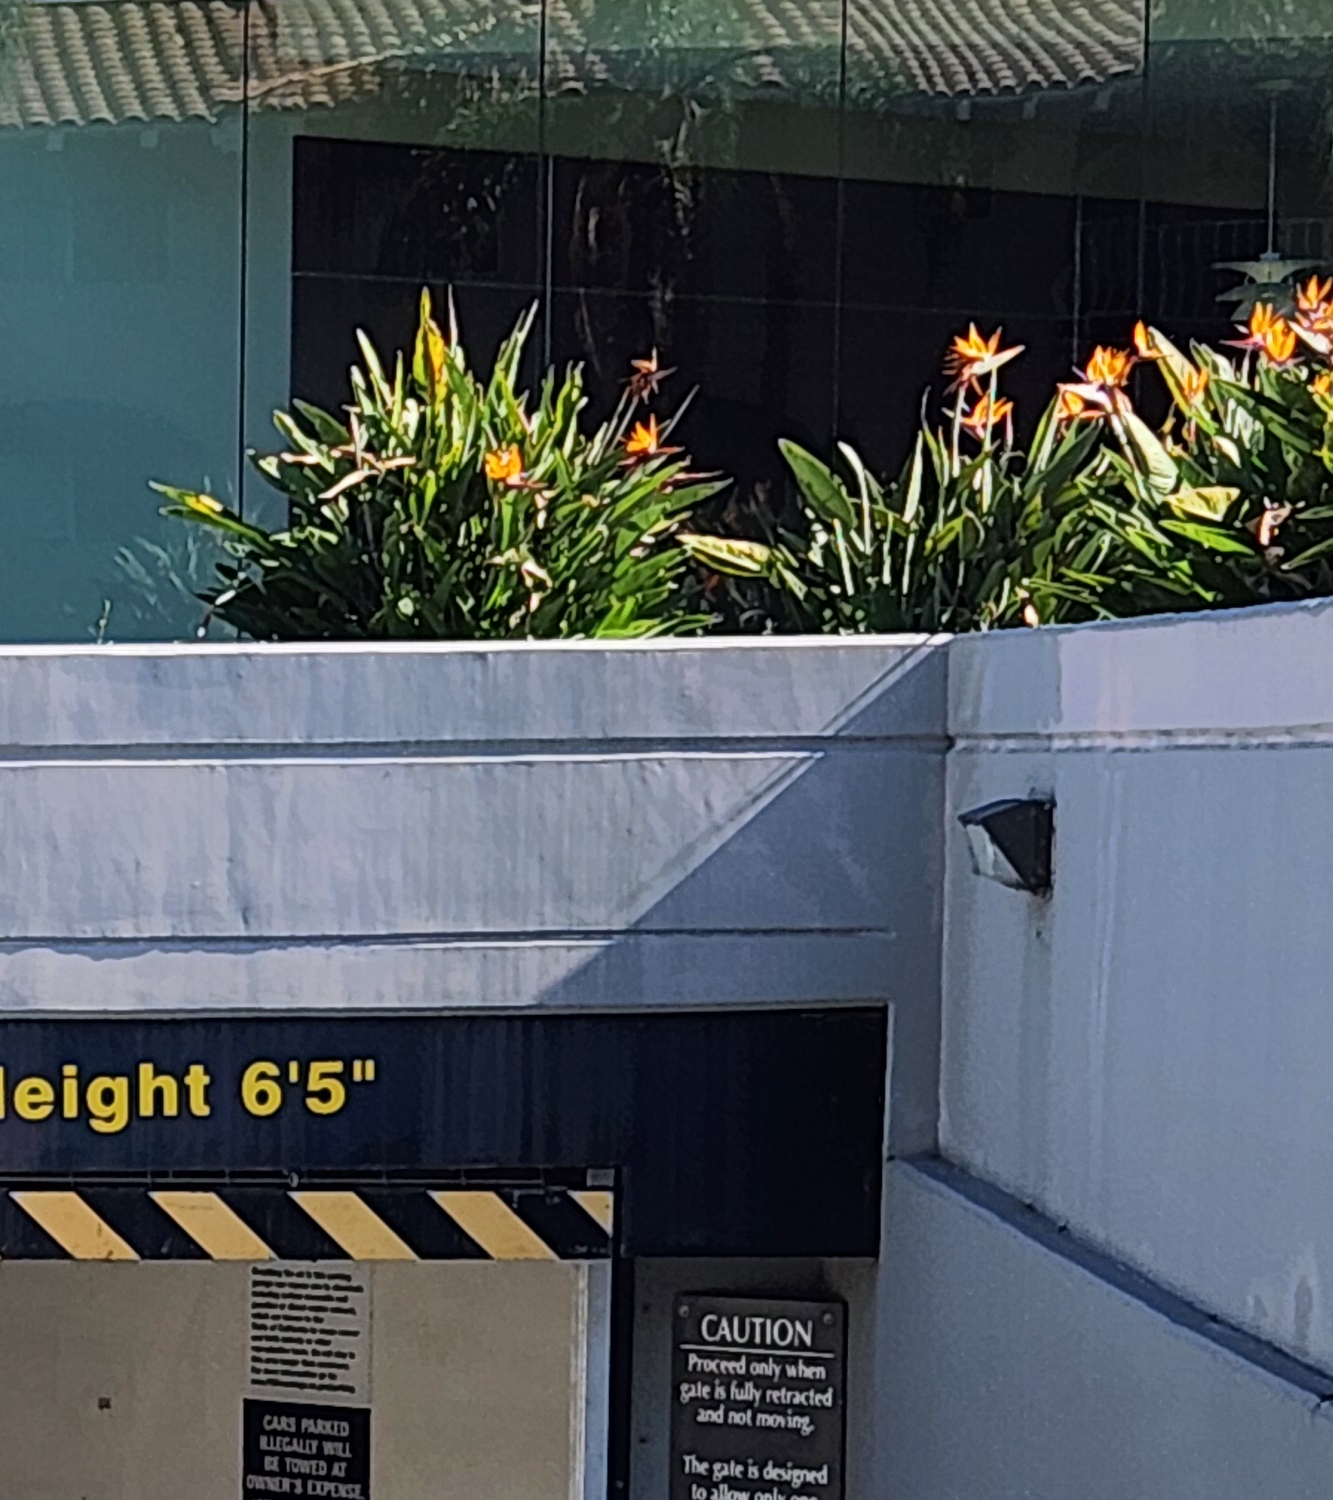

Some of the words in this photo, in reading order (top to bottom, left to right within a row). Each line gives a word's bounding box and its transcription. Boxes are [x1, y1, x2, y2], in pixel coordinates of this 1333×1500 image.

[241, 1060, 374, 1116] 6'5"
[701, 1314, 812, 1346] CAUTION
[688, 1353, 745, 1375] Proceed
[750, 1358, 781, 1382] only
[786, 1360, 825, 1380] when
[680, 1381, 710, 1404] gate
[714, 1379, 726, 1399] is
[731, 1381, 761, 1407] fully
[766, 1387, 832, 1407] retracted
[263, 1414, 296, 1432] CARS
[301, 1418, 349, 1436] PARKED
[696, 1404, 724, 1424] and
[728, 1408, 752, 1426] not
[756, 1409, 815, 1436] moving.
[260, 1435, 318, 1454] ILLEGALLY
[323, 1441, 352, 1457] WILL
[264, 1456, 279, 1471] BE
[285, 1457, 327, 1475] TOWED
[332, 1462, 347, 1477] AT
[683, 1455, 709, 1475] The
[713, 1460, 744, 1481] gate
[748, 1458, 759, 1479] is
[763, 1460, 828, 1488] designed
[692, 1484, 707, 1500] to
